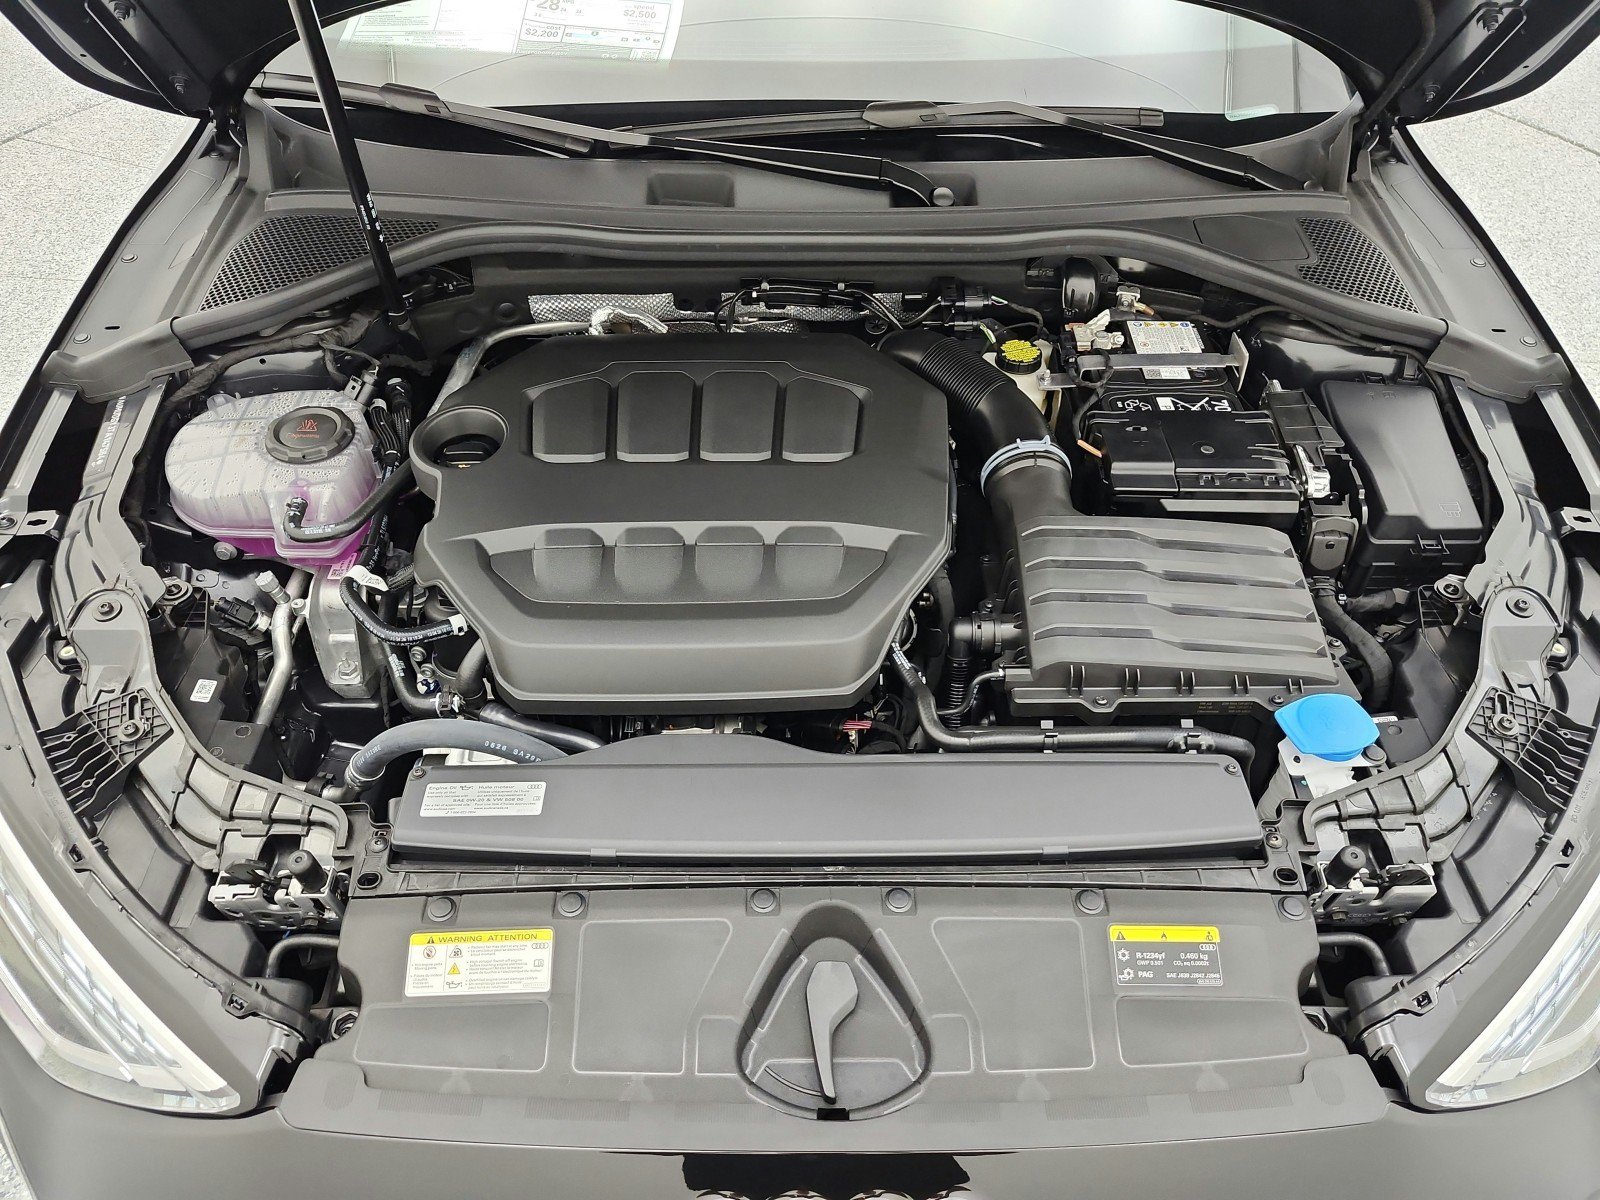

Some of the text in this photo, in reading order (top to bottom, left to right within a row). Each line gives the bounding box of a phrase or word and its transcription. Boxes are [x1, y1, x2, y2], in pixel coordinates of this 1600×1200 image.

[623, 9, 656, 18] $2,500
[525, 28, 558, 37] $2,200
[438, 935, 482, 943] WARNING
[1136, 952, 1166, 960] R-1234yf
